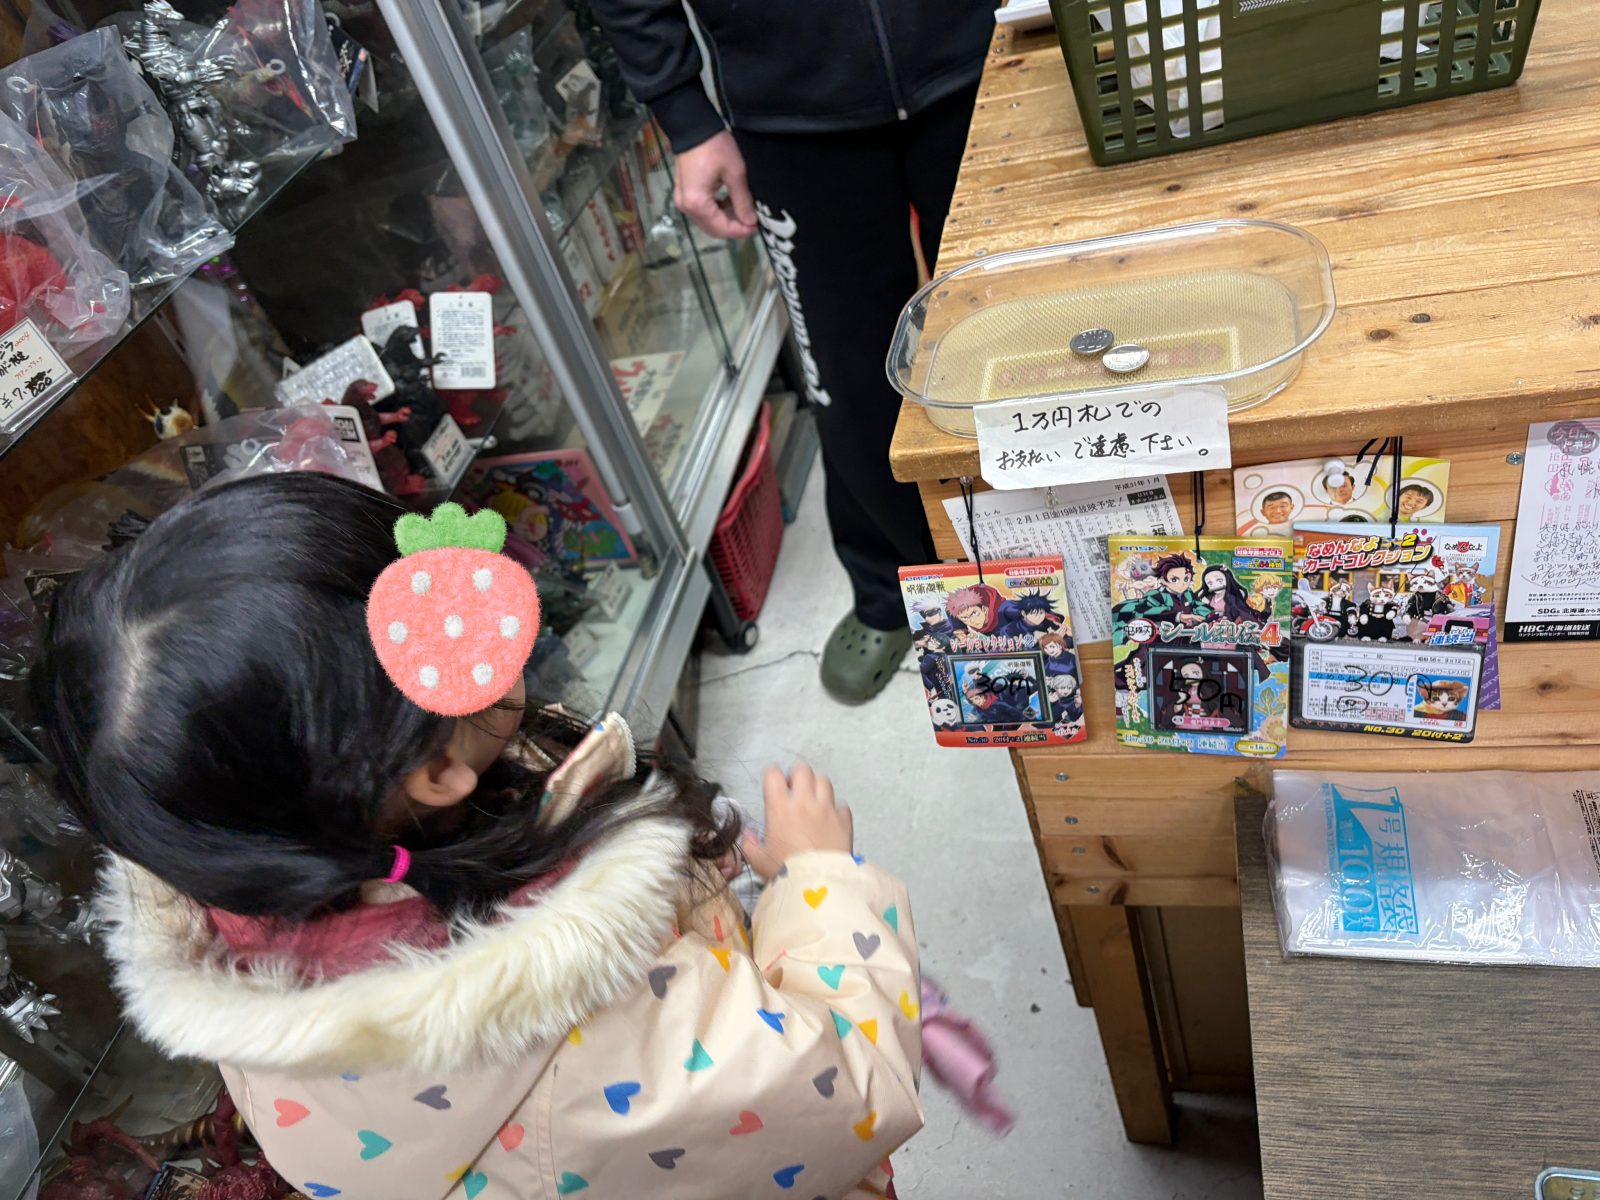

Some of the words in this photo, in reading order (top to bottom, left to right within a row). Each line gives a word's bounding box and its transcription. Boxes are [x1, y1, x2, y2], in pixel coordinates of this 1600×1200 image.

[1011, 400, 1162, 433] 1万円札での
[1444, 542, 1484, 552] なめんなよ
[1303, 544, 1432, 574] カードコレクション
[1518, 625, 1546, 633] HBC
[1546, 623, 1591, 632] 北海道放送
